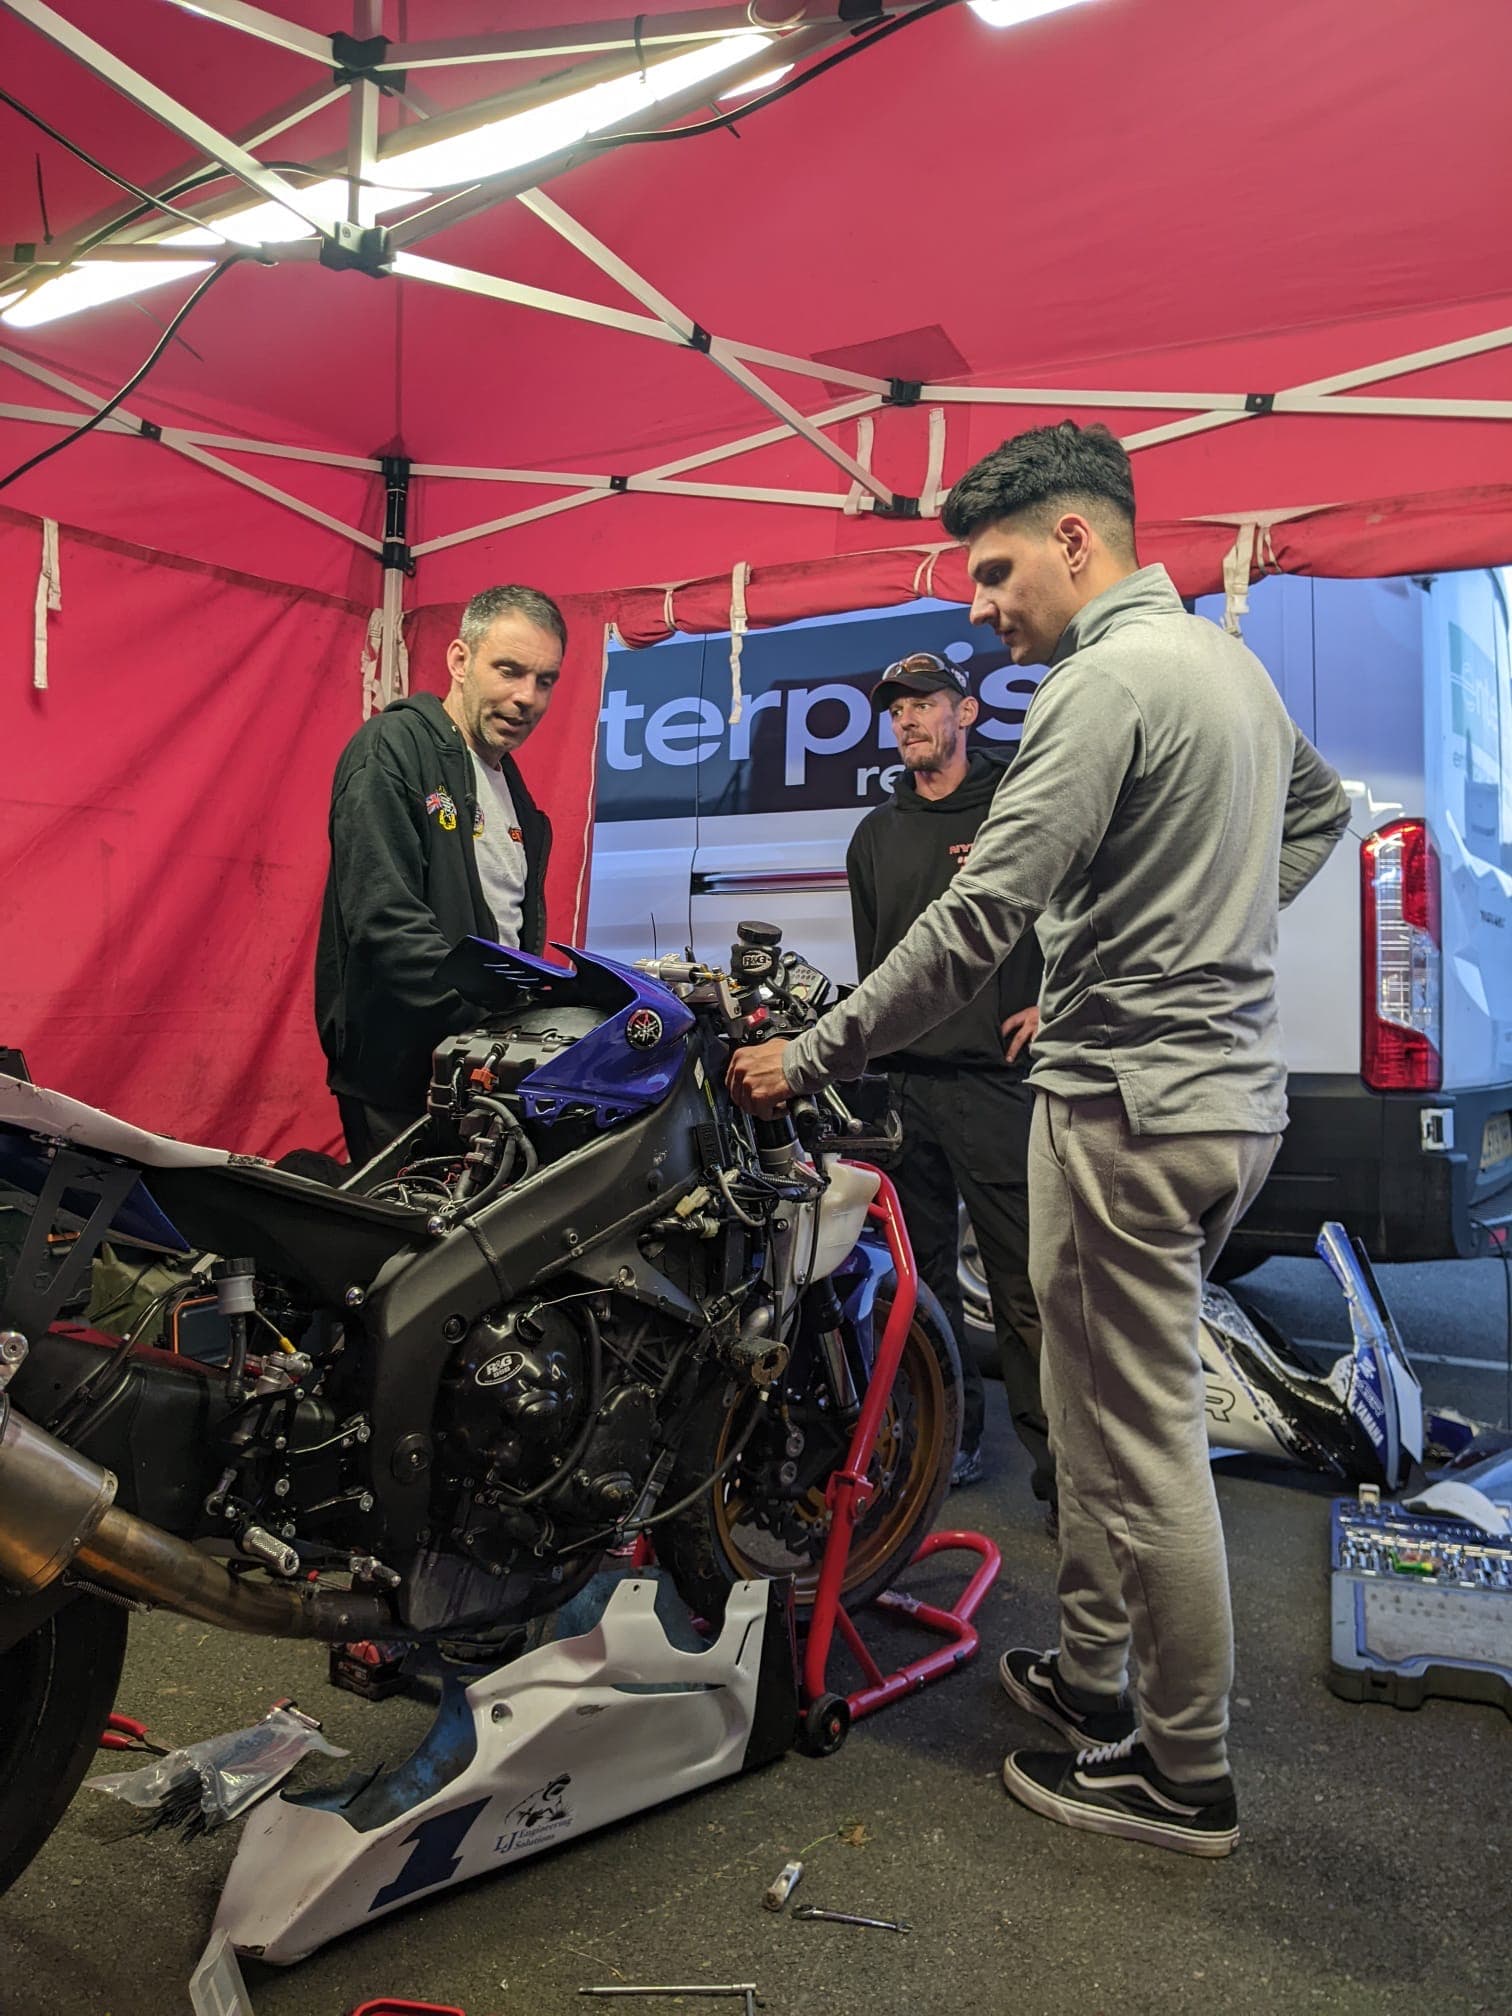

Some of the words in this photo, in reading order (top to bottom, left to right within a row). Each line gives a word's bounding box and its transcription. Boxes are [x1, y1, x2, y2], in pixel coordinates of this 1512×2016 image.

[600, 642, 1049, 786] terps
[486, 1355, 513, 1375] R&G
[1355, 1400, 1384, 1447] YAMAHA
[493, 1831, 519, 1853] LJ
